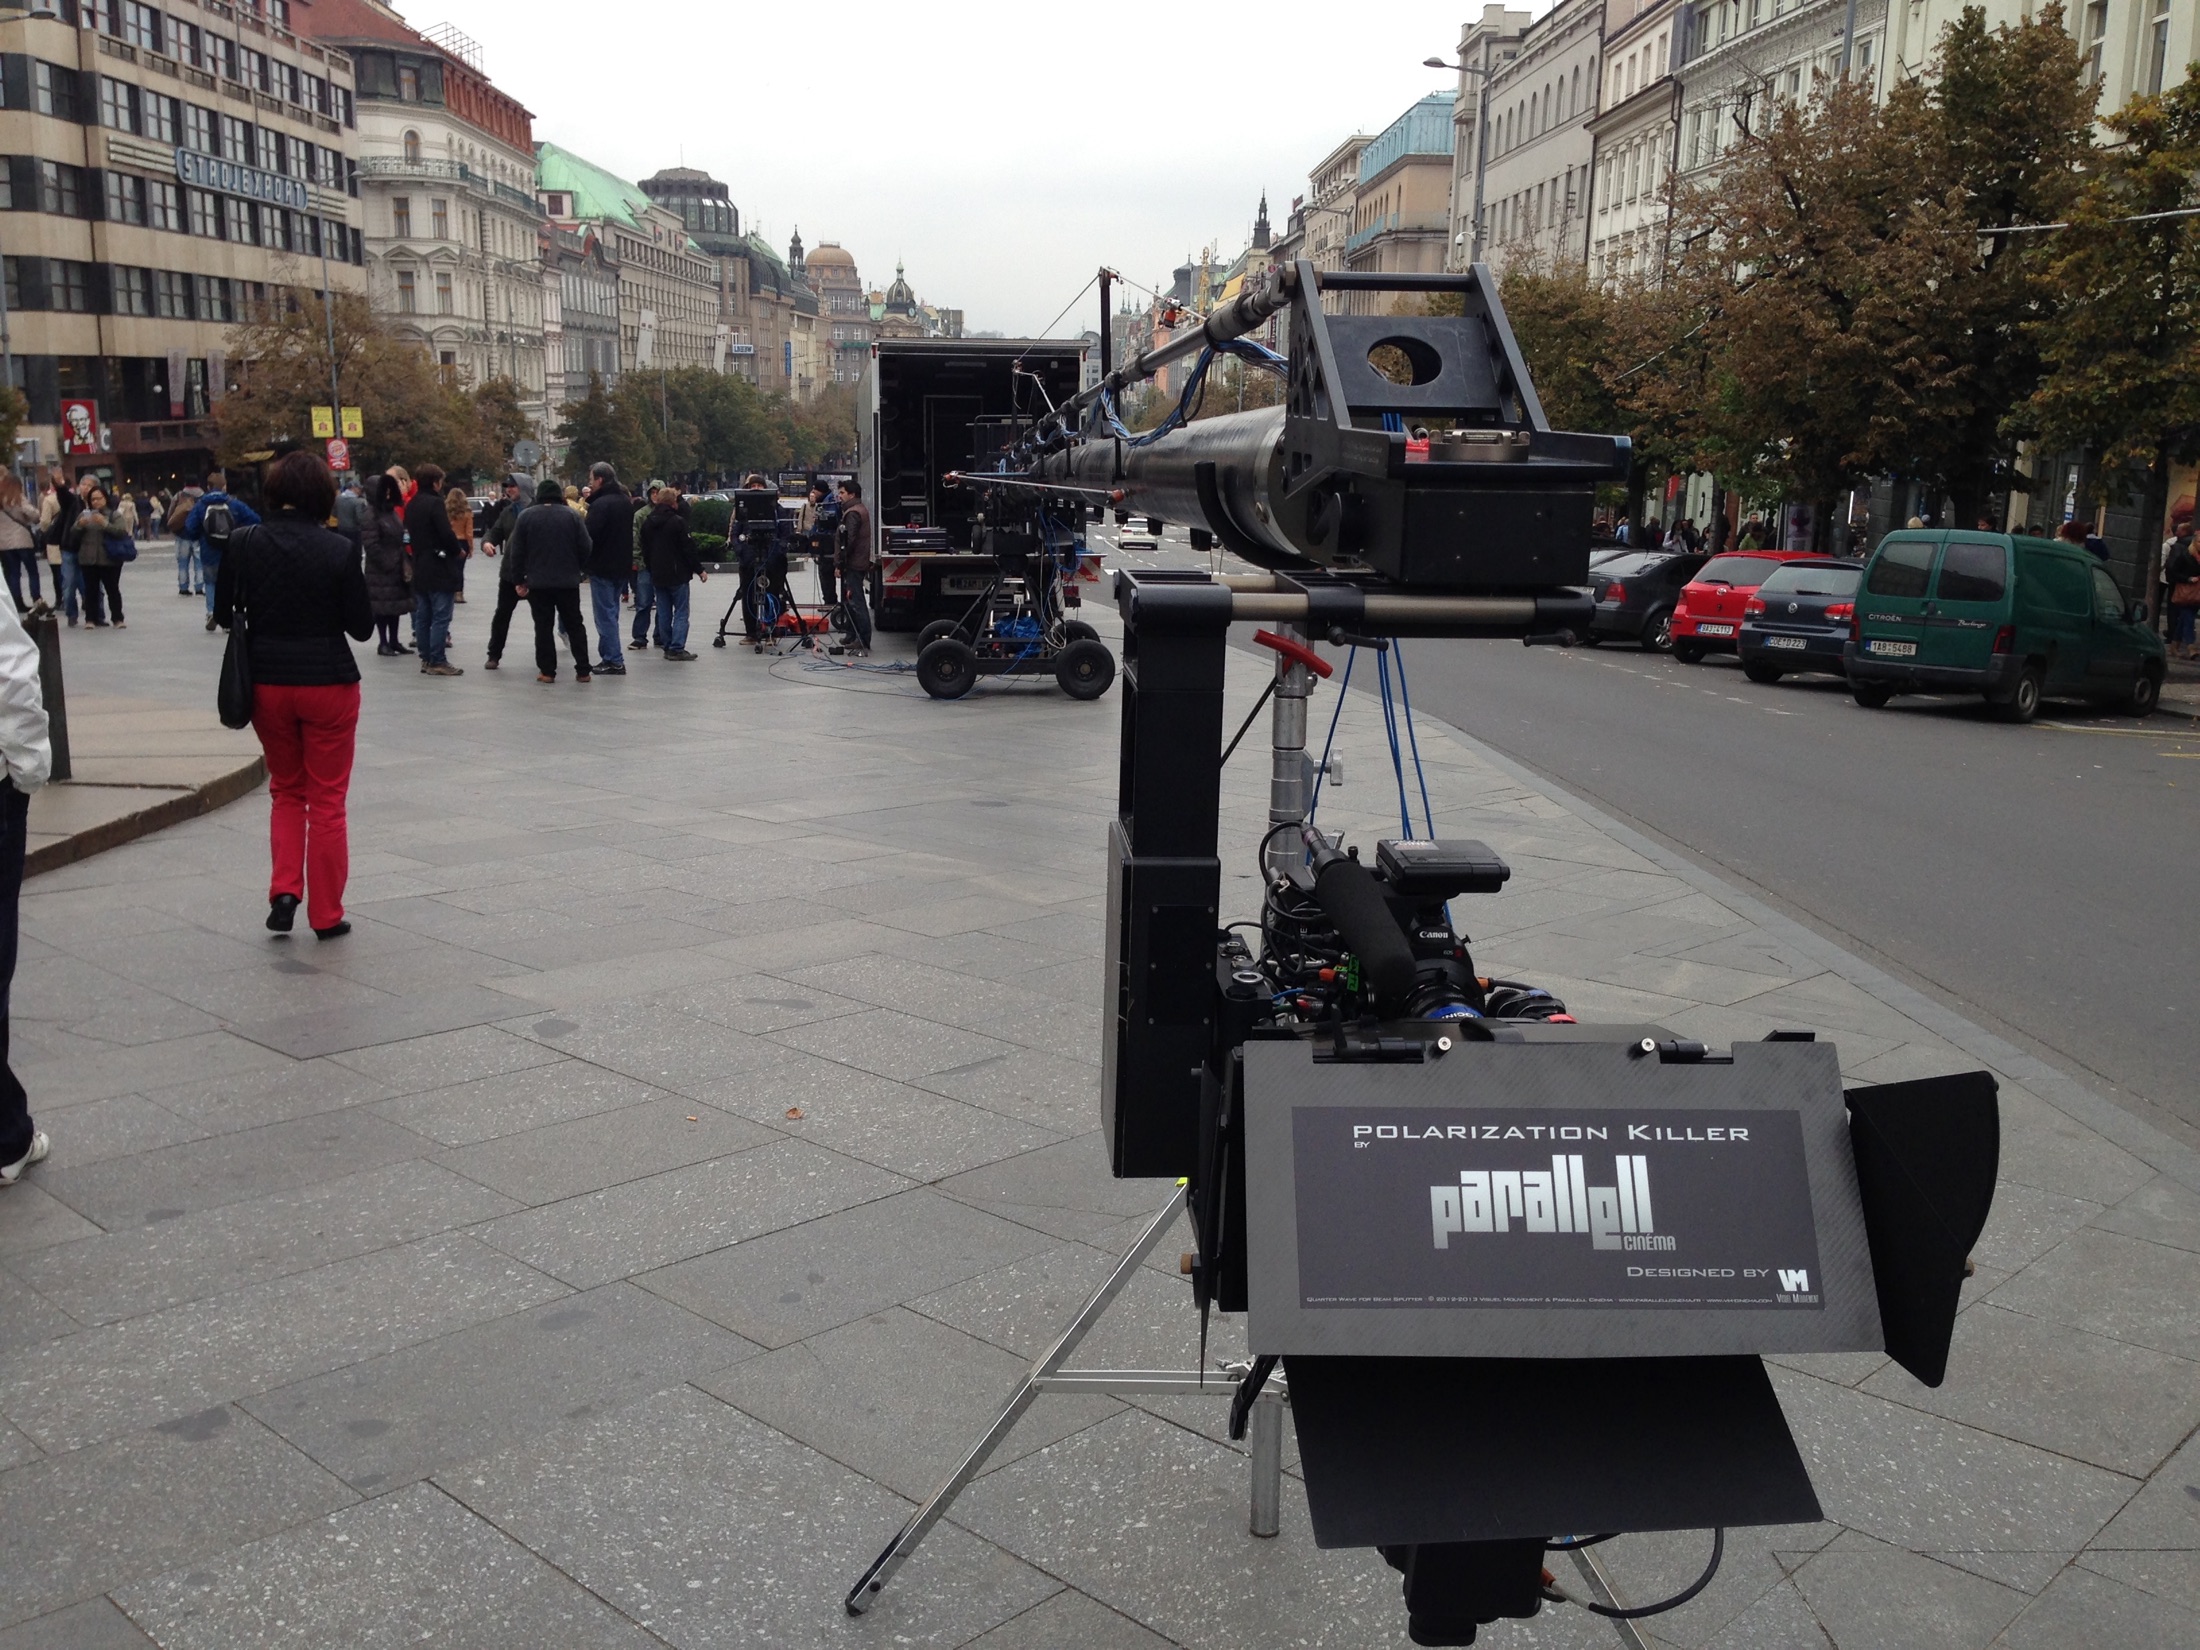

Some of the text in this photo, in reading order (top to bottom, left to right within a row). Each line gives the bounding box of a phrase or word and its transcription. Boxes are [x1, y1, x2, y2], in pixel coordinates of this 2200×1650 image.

[183, 152, 302, 204] STROJEXPORT
[1868, 613, 1902, 622] CITROËN
[1957, 619, 1987, 629] Berlingo
[1873, 642, 1887, 652] 1A8
[1419, 930, 1449, 939] Canon
[1353, 1125, 1608, 1140] POLARIZATION
[1354, 1141, 1371, 1149] BY
[1743, 1268, 1770, 1278] BY
[1777, 1269, 1809, 1292] VM
